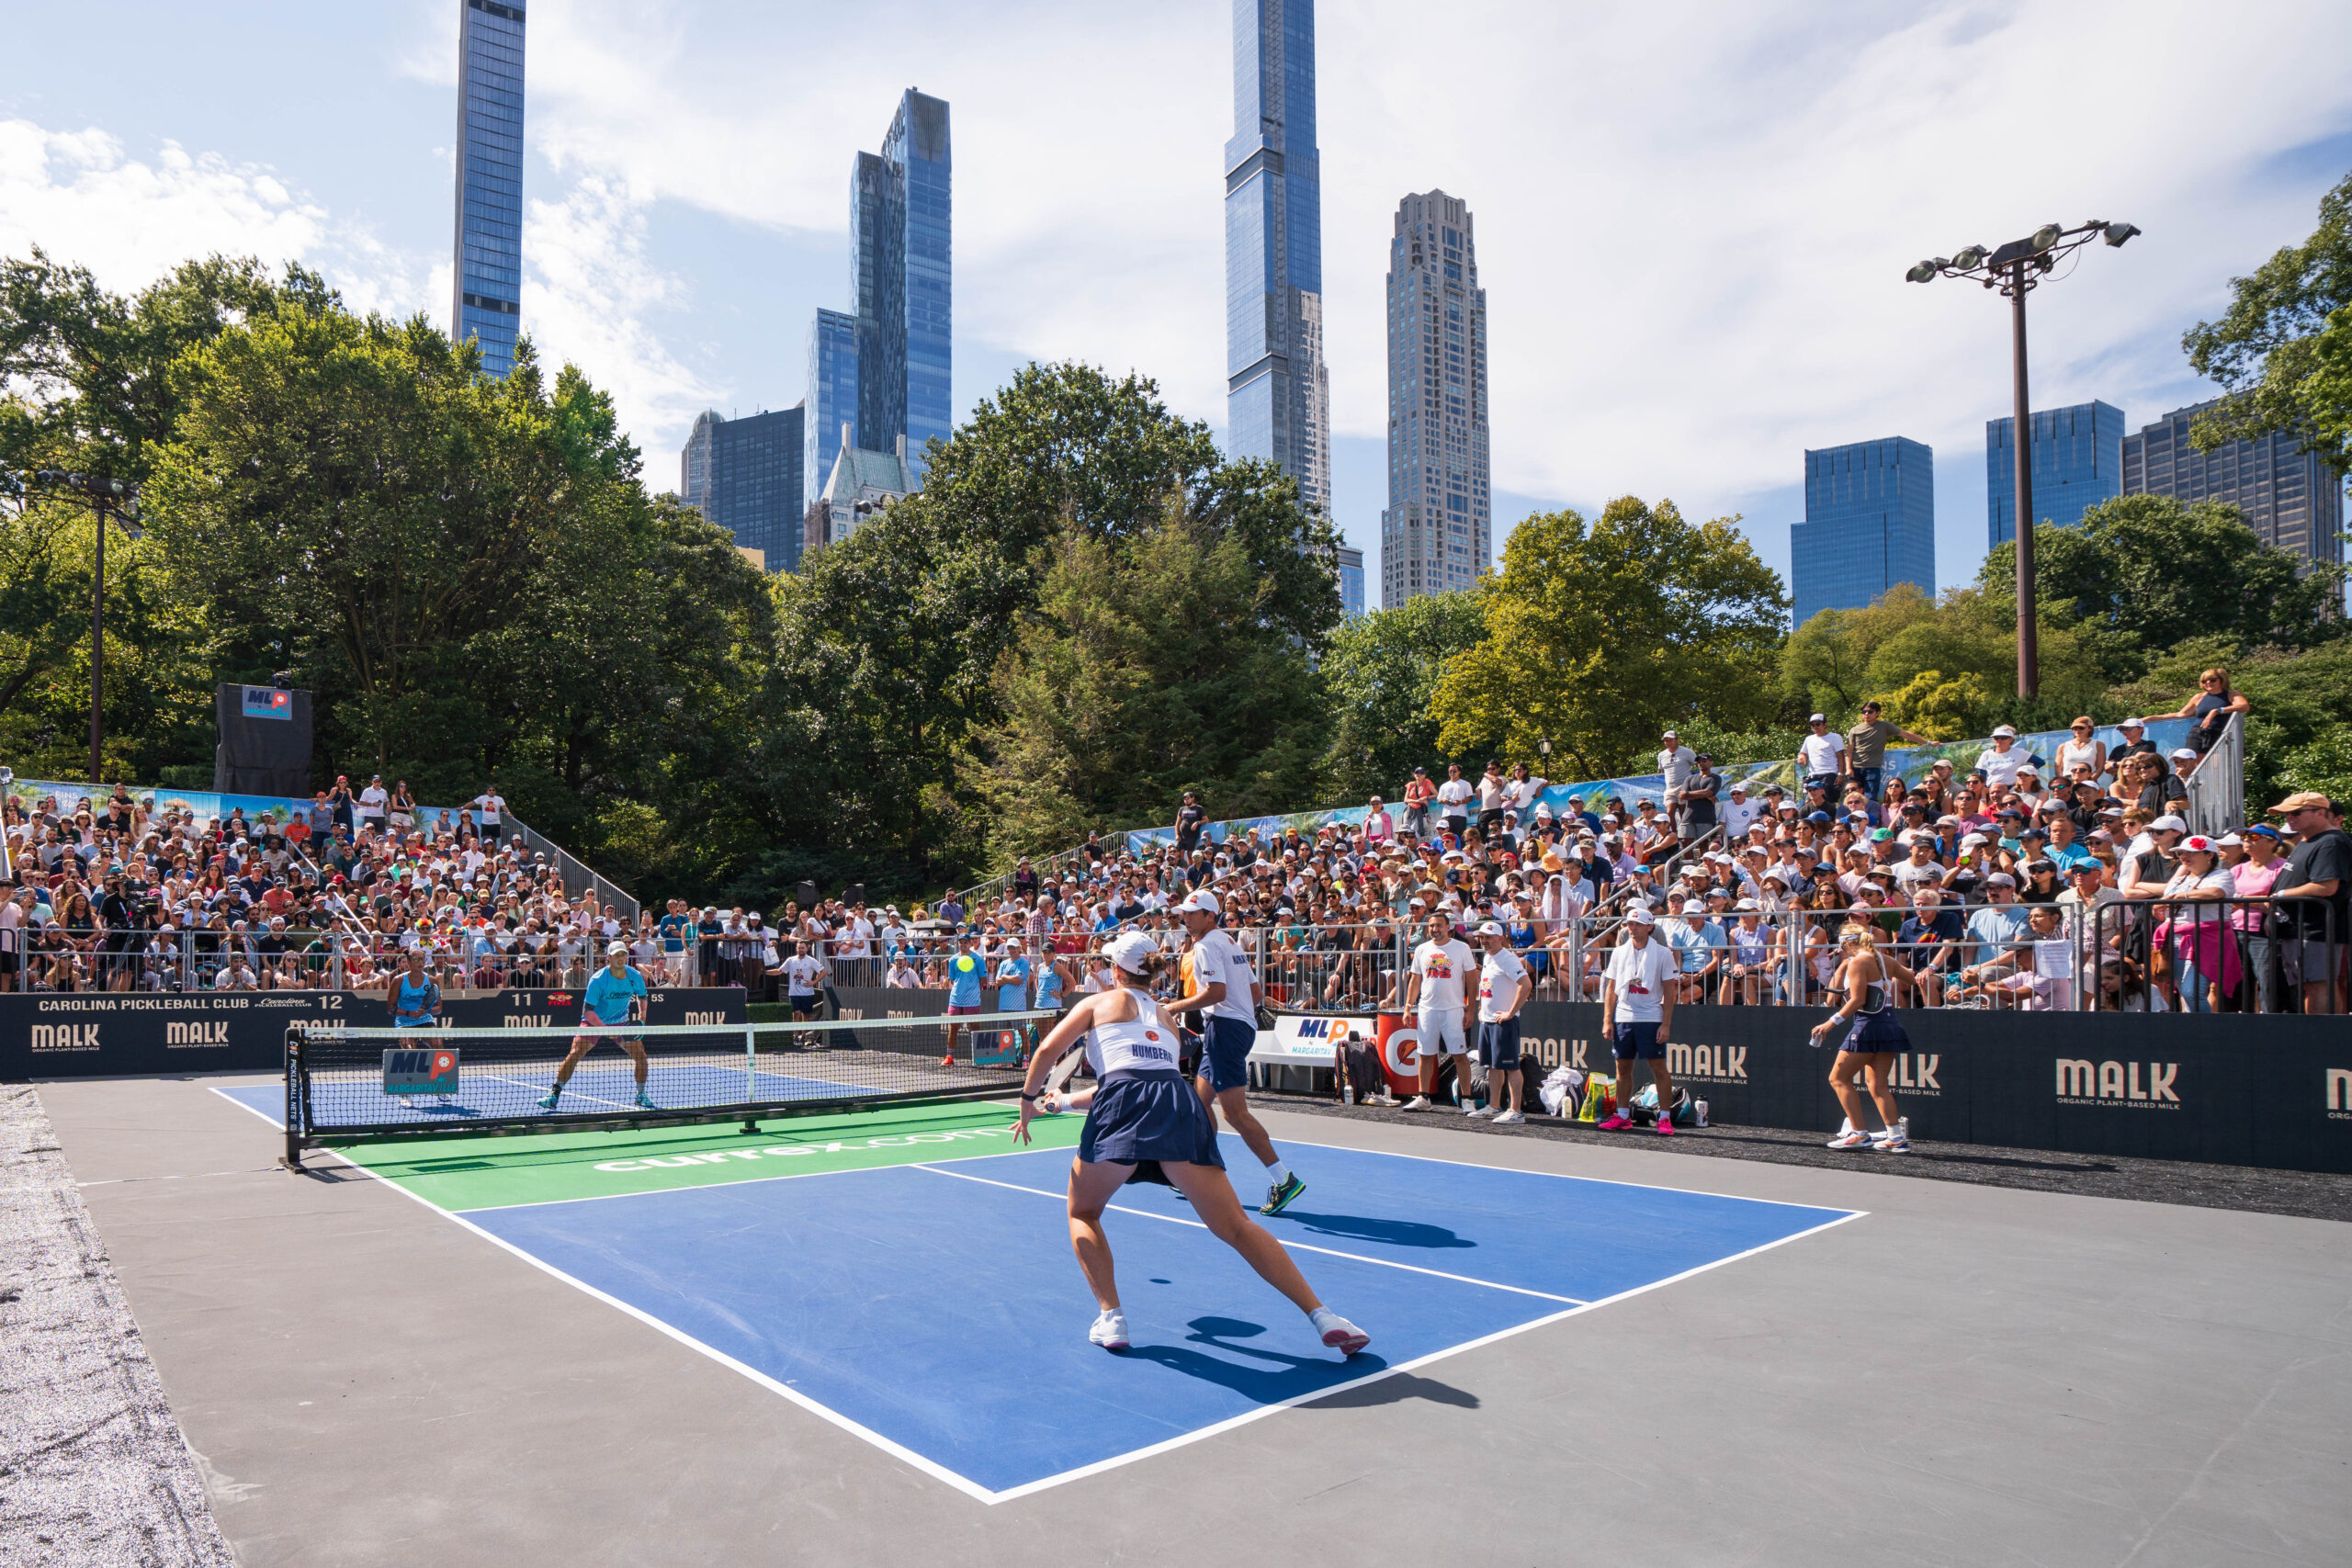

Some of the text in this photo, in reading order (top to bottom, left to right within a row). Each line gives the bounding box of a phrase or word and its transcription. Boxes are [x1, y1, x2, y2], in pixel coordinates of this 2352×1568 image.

[247, 690, 288, 709] MLP
[39, 998, 249, 1011] CAROLINA PICKLEBALL CLUB
[318, 995, 343, 1010] 12
[512, 993, 531, 1007] 11
[31, 1023, 101, 1048] MALK
[166, 1021, 230, 1044] MALK
[976, 1031, 1013, 1053] MLP
[1297, 1019, 1349, 1043] MLP
[1131, 1043, 1173, 1064] HUMBERG
[1385, 1028, 1419, 1077] G
[1520, 1037, 1589, 1068] MALK
[1666, 1043, 1747, 1077] MALK
[390, 1051, 456, 1080] MLP
[386, 1083, 458, 1094] MARGARITAVILLE
[1693, 1076, 1732, 1084] PLANT-BASED
[2056, 1058, 2181, 1101] MALK
[2056, 1097, 2095, 1105] ORGANIC
[2097, 1100, 2156, 1110] PLANT-BASED
[593, 1128, 1017, 1172] currex.com
